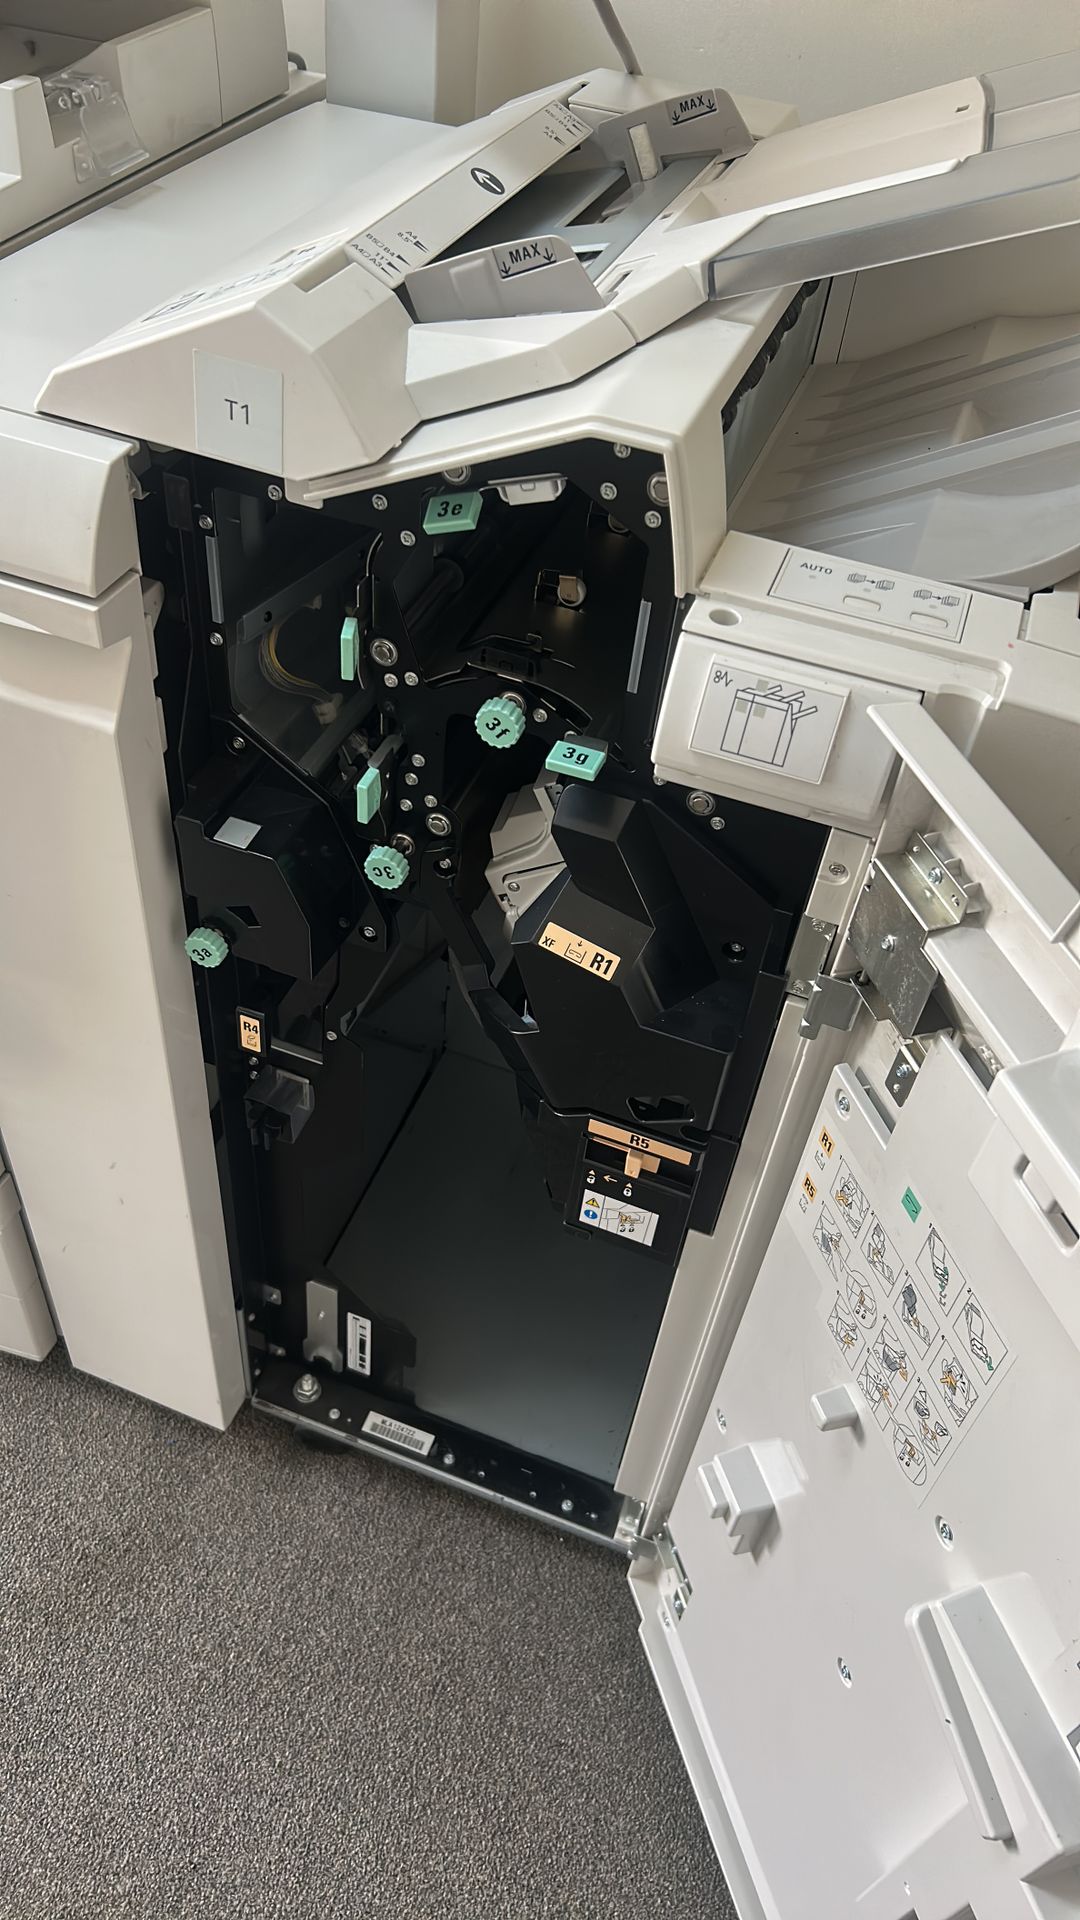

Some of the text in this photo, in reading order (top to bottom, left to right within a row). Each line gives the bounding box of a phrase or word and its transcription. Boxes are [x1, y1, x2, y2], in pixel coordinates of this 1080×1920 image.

[679, 94, 705, 113] MAX
[405, 230, 418, 240] A4
[509, 242, 541, 264] MAX
[224, 398, 249, 425] T1
[437, 500, 463, 518] 3e
[800, 562, 834, 576] AUTO
[485, 717, 511, 739] 3f
[562, 746, 589, 765] 3g
[372, 865, 395, 880] 3c
[192, 948, 212, 961] 3a
[541, 935, 614, 976] XF R1
[243, 1021, 259, 1034] R4
[629, 1134, 650, 1149] R5
[821, 1132, 833, 1153] R1
[804, 1177, 816, 1198] R5
